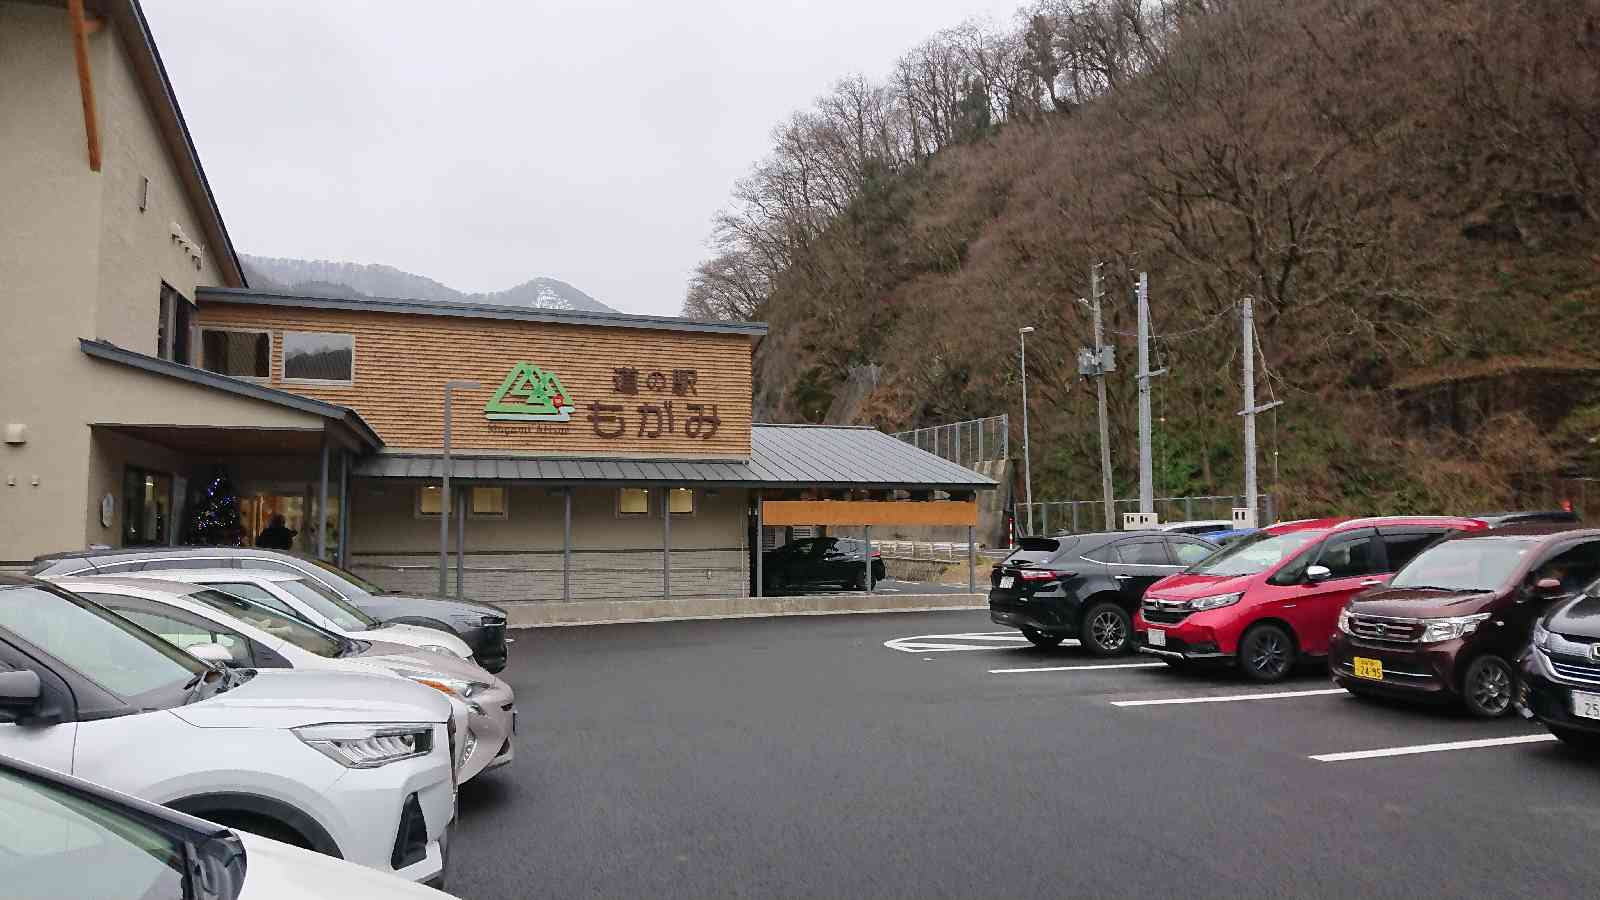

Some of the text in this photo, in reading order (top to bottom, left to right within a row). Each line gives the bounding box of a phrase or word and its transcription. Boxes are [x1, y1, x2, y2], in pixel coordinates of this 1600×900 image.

[612, 366, 699, 396] 道の駅
[586, 400, 722, 440] もがみ
